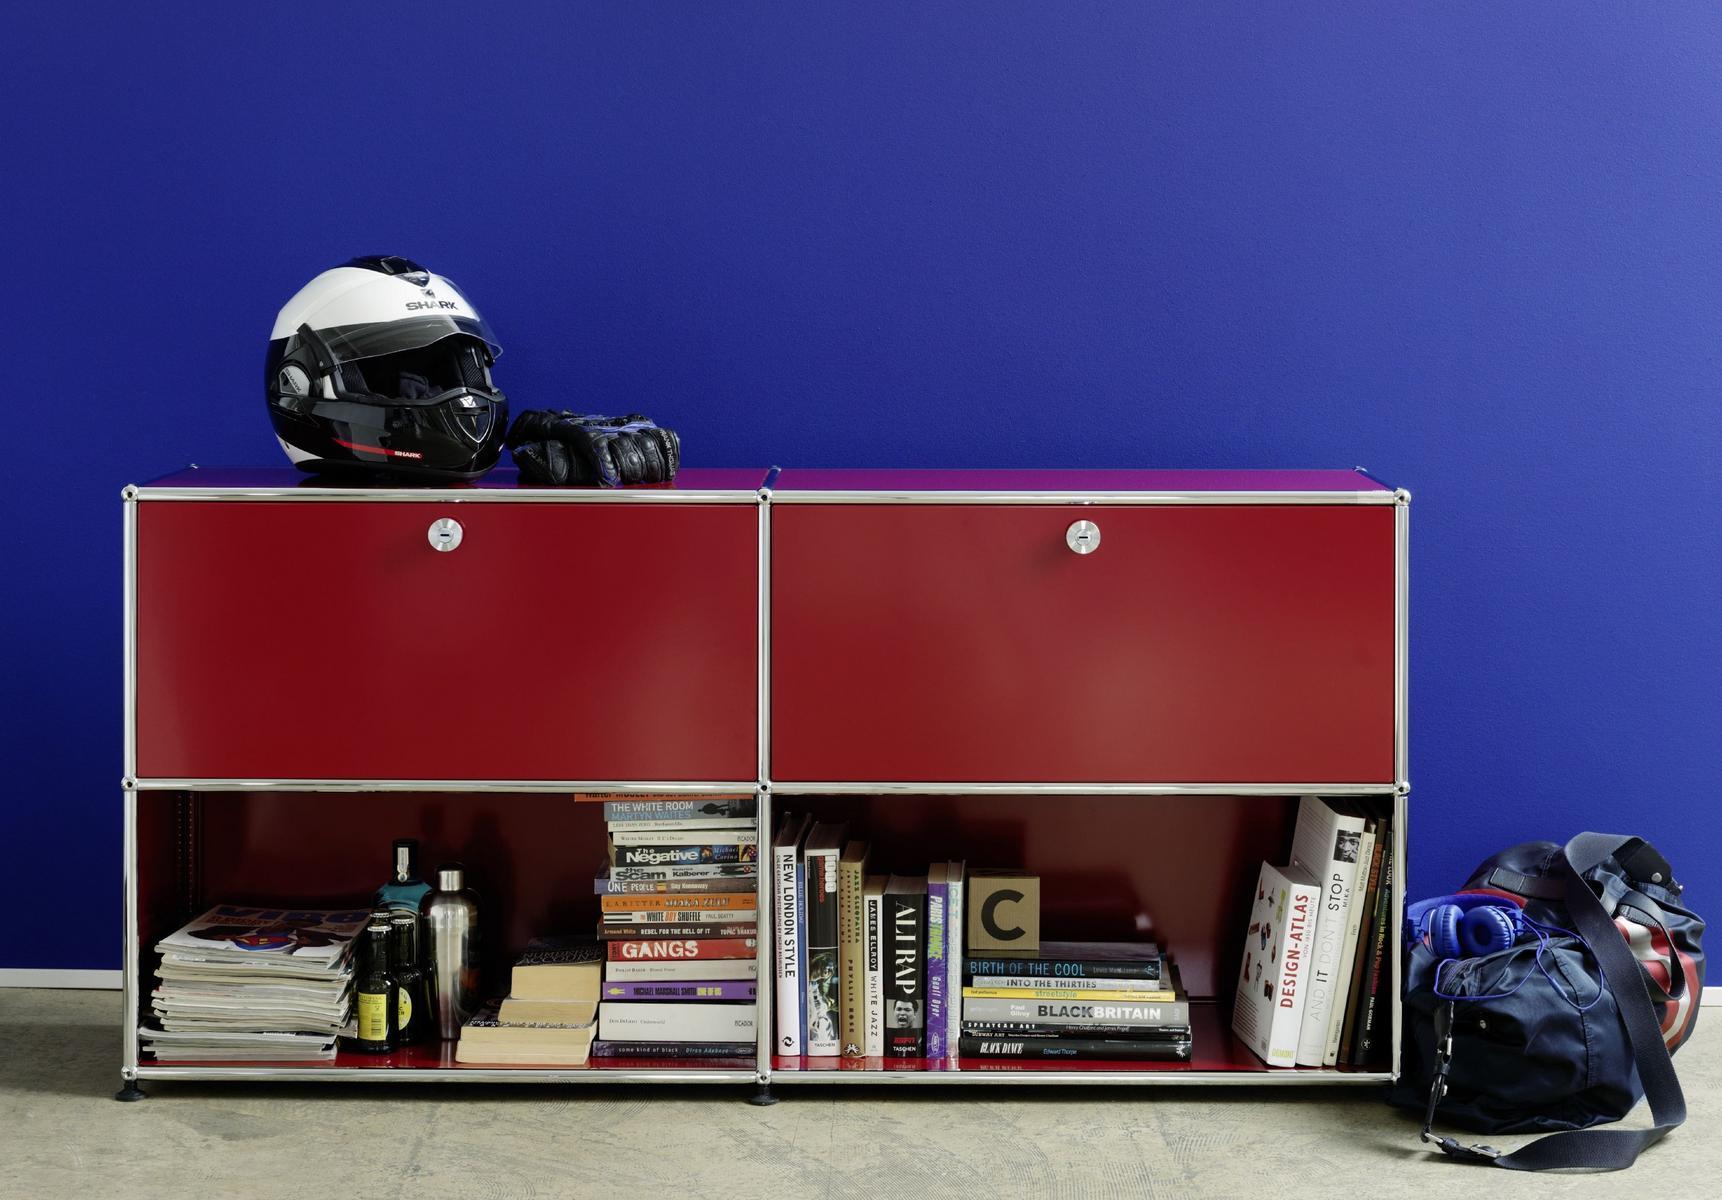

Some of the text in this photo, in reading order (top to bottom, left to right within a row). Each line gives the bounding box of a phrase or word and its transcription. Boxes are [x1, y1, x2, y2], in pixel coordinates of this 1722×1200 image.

[406, 301, 458, 311] SHARK
[394, 450, 422, 459] SHARK
[611, 801, 694, 812] THE WHITE ROOM
[611, 810, 691, 820] MARTYN WAITES
[626, 850, 698, 864] Negative
[616, 871, 666, 881] Scam
[608, 881, 628, 892] ONE
[631, 884, 654, 892] PEOPLE
[1328, 874, 1344, 911] STOP
[783, 854, 796, 978] NEW LONDON STYLE
[930, 895, 943, 923] PARIS
[981, 889, 1026, 941] C
[646, 912, 664, 922] WHITE
[665, 912, 678, 922] BOY
[678, 912, 700, 922] SHUFFLE
[622, 940, 699, 958] GANGS
[1280, 895, 1309, 1008] DESIGN-ATLAS
[896, 949, 916, 994] RAP
[970, 962, 1004, 974] BIRTH
[1009, 962, 1024, 974] OF
[1028, 963, 1050, 974] THE
[1055, 963, 1085, 976] COOL
[1316, 970, 1328, 982] IT
[932, 976, 941, 996] Geoff
[1035, 990, 1077, 998] streetstyle
[932, 1000, 941, 1016] Dyer
[1038, 1005, 1093, 1018] BLACK
[1093, 1007, 1161, 1020] BRITAIN
[1310, 990, 1325, 1021] AND
